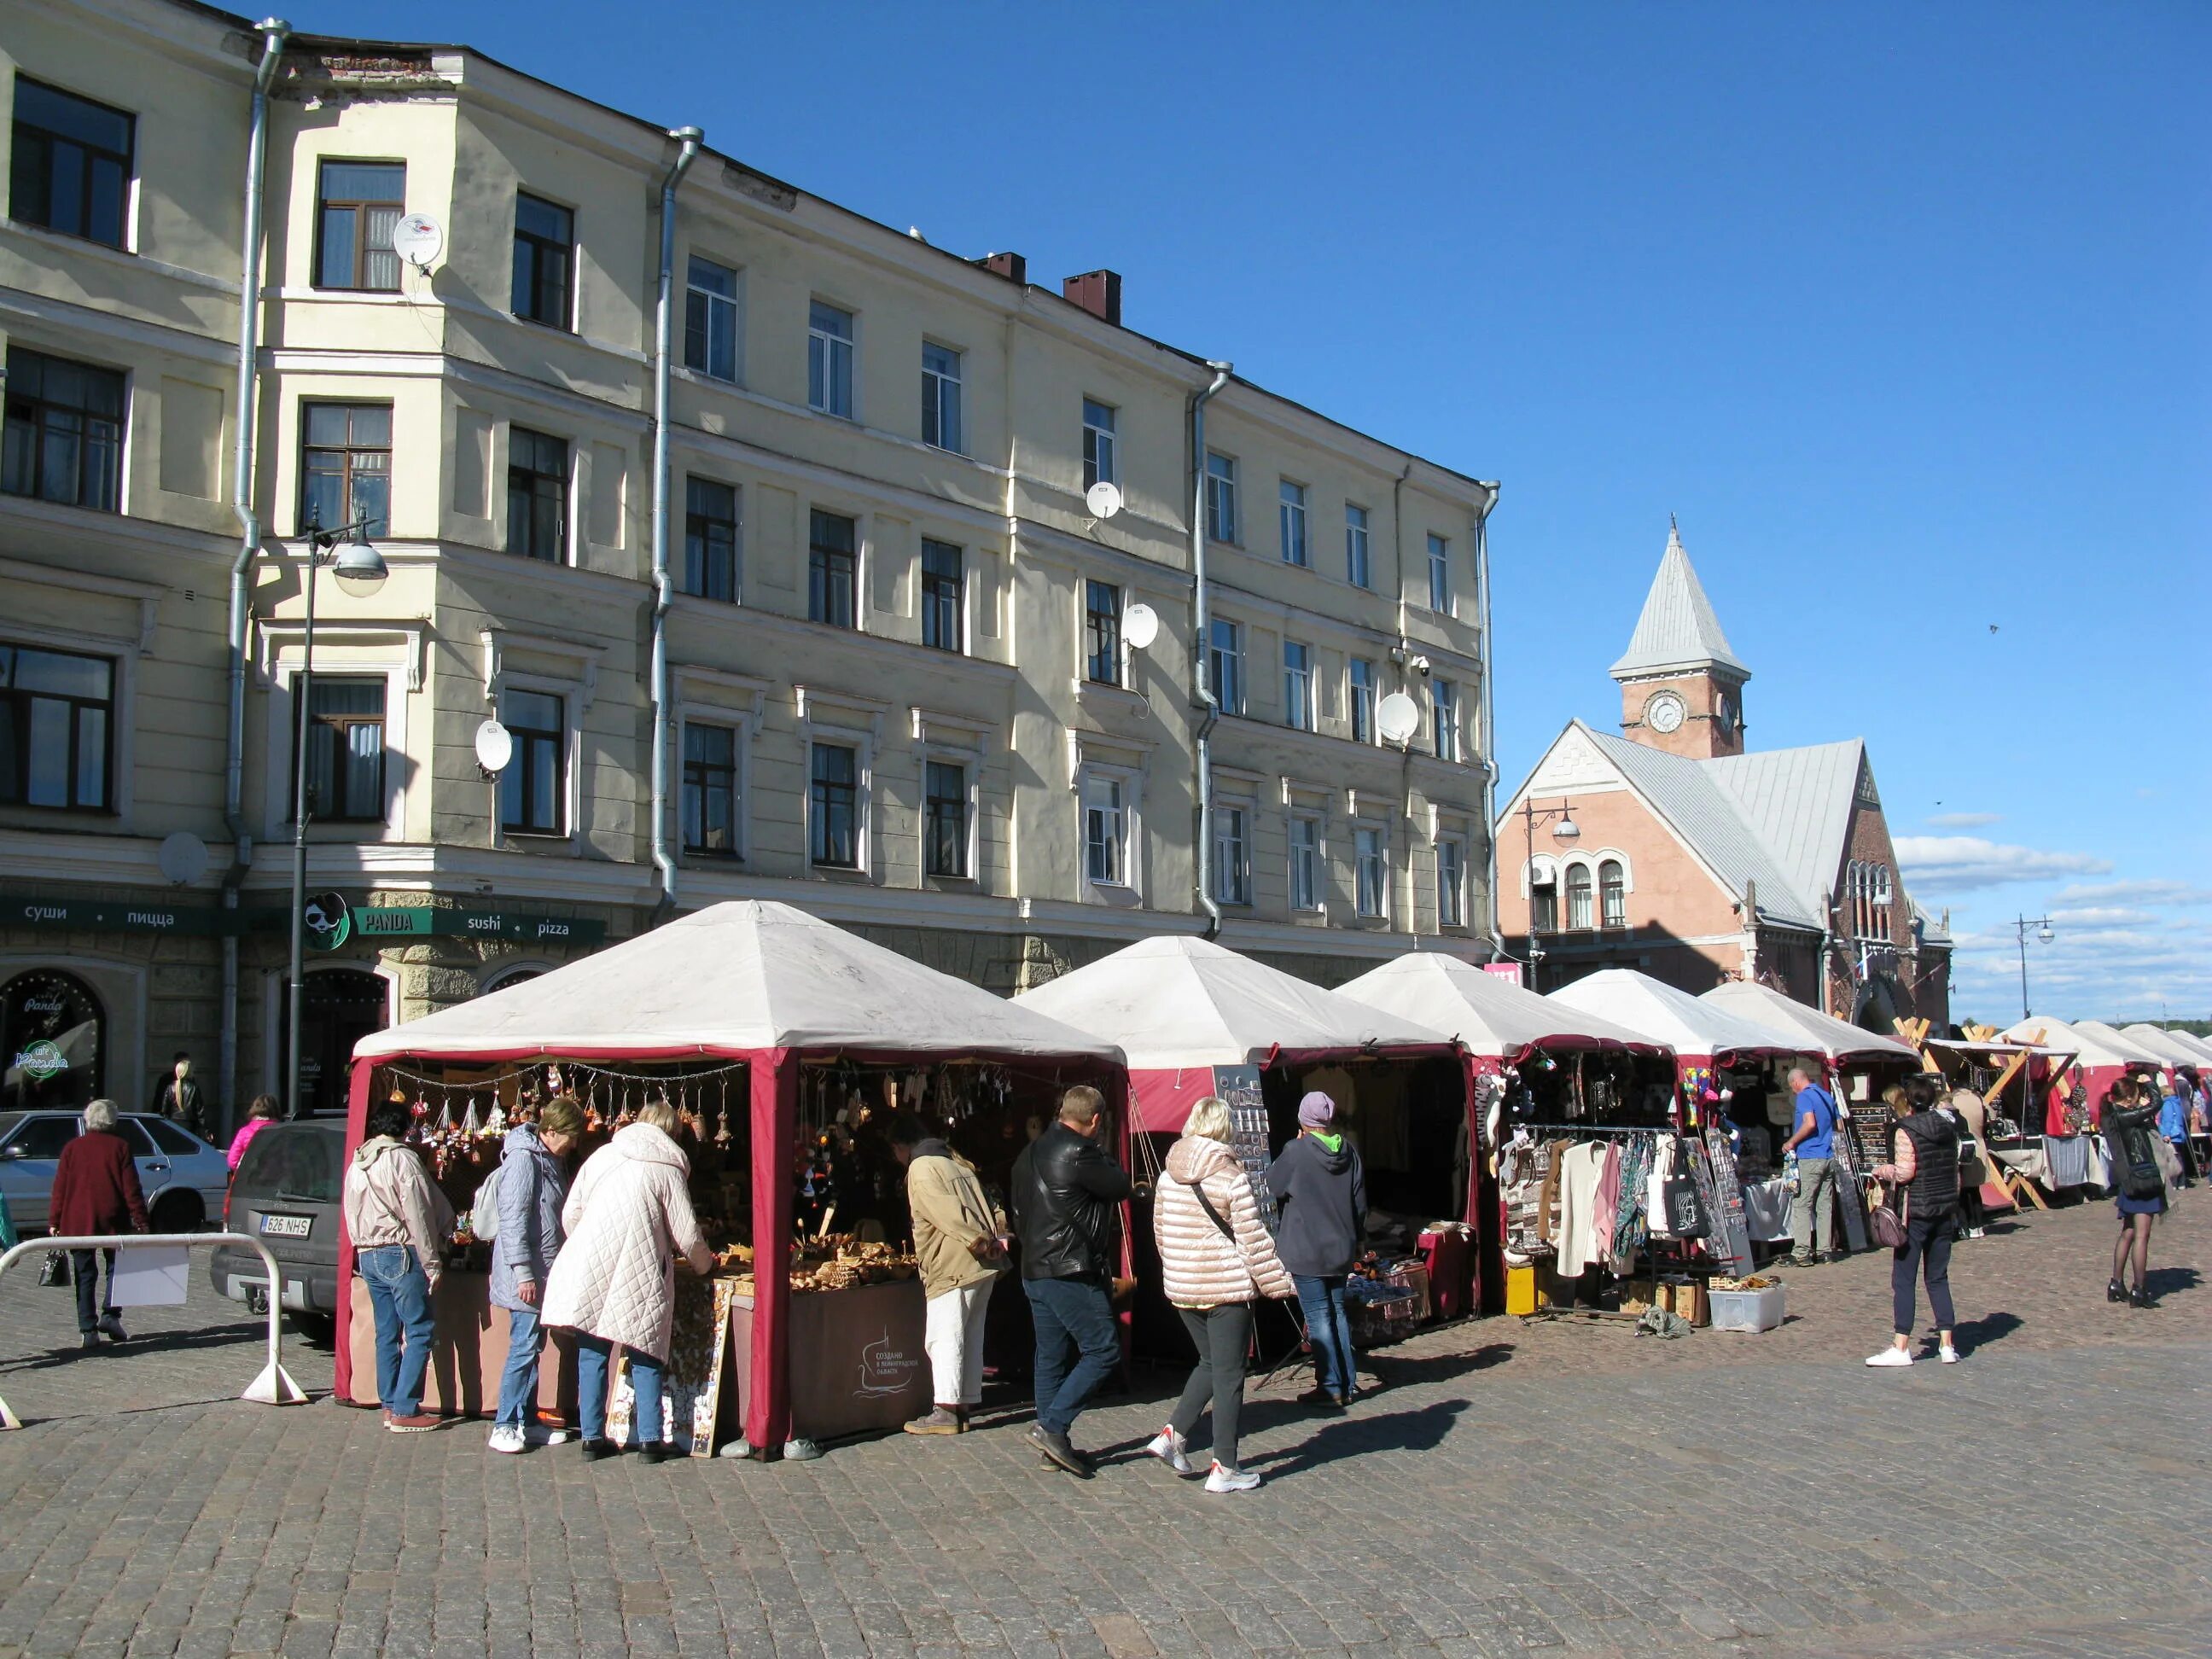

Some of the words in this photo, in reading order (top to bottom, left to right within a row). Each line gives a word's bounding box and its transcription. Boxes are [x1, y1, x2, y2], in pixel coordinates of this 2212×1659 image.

[25, 906, 67, 922] суши
[127, 911, 174, 927] пицца
[364, 914, 413, 931] PANDA
[468, 915, 501, 930] sushi
[538, 919, 569, 937] pizza
[24, 998, 61, 1012] Panda
[15, 1052, 68, 1068] Panda
[267, 1218, 284, 1232] 626
[285, 1220, 307, 1234] NHS
[876, 1352, 903, 1360] СОЗДАНО
